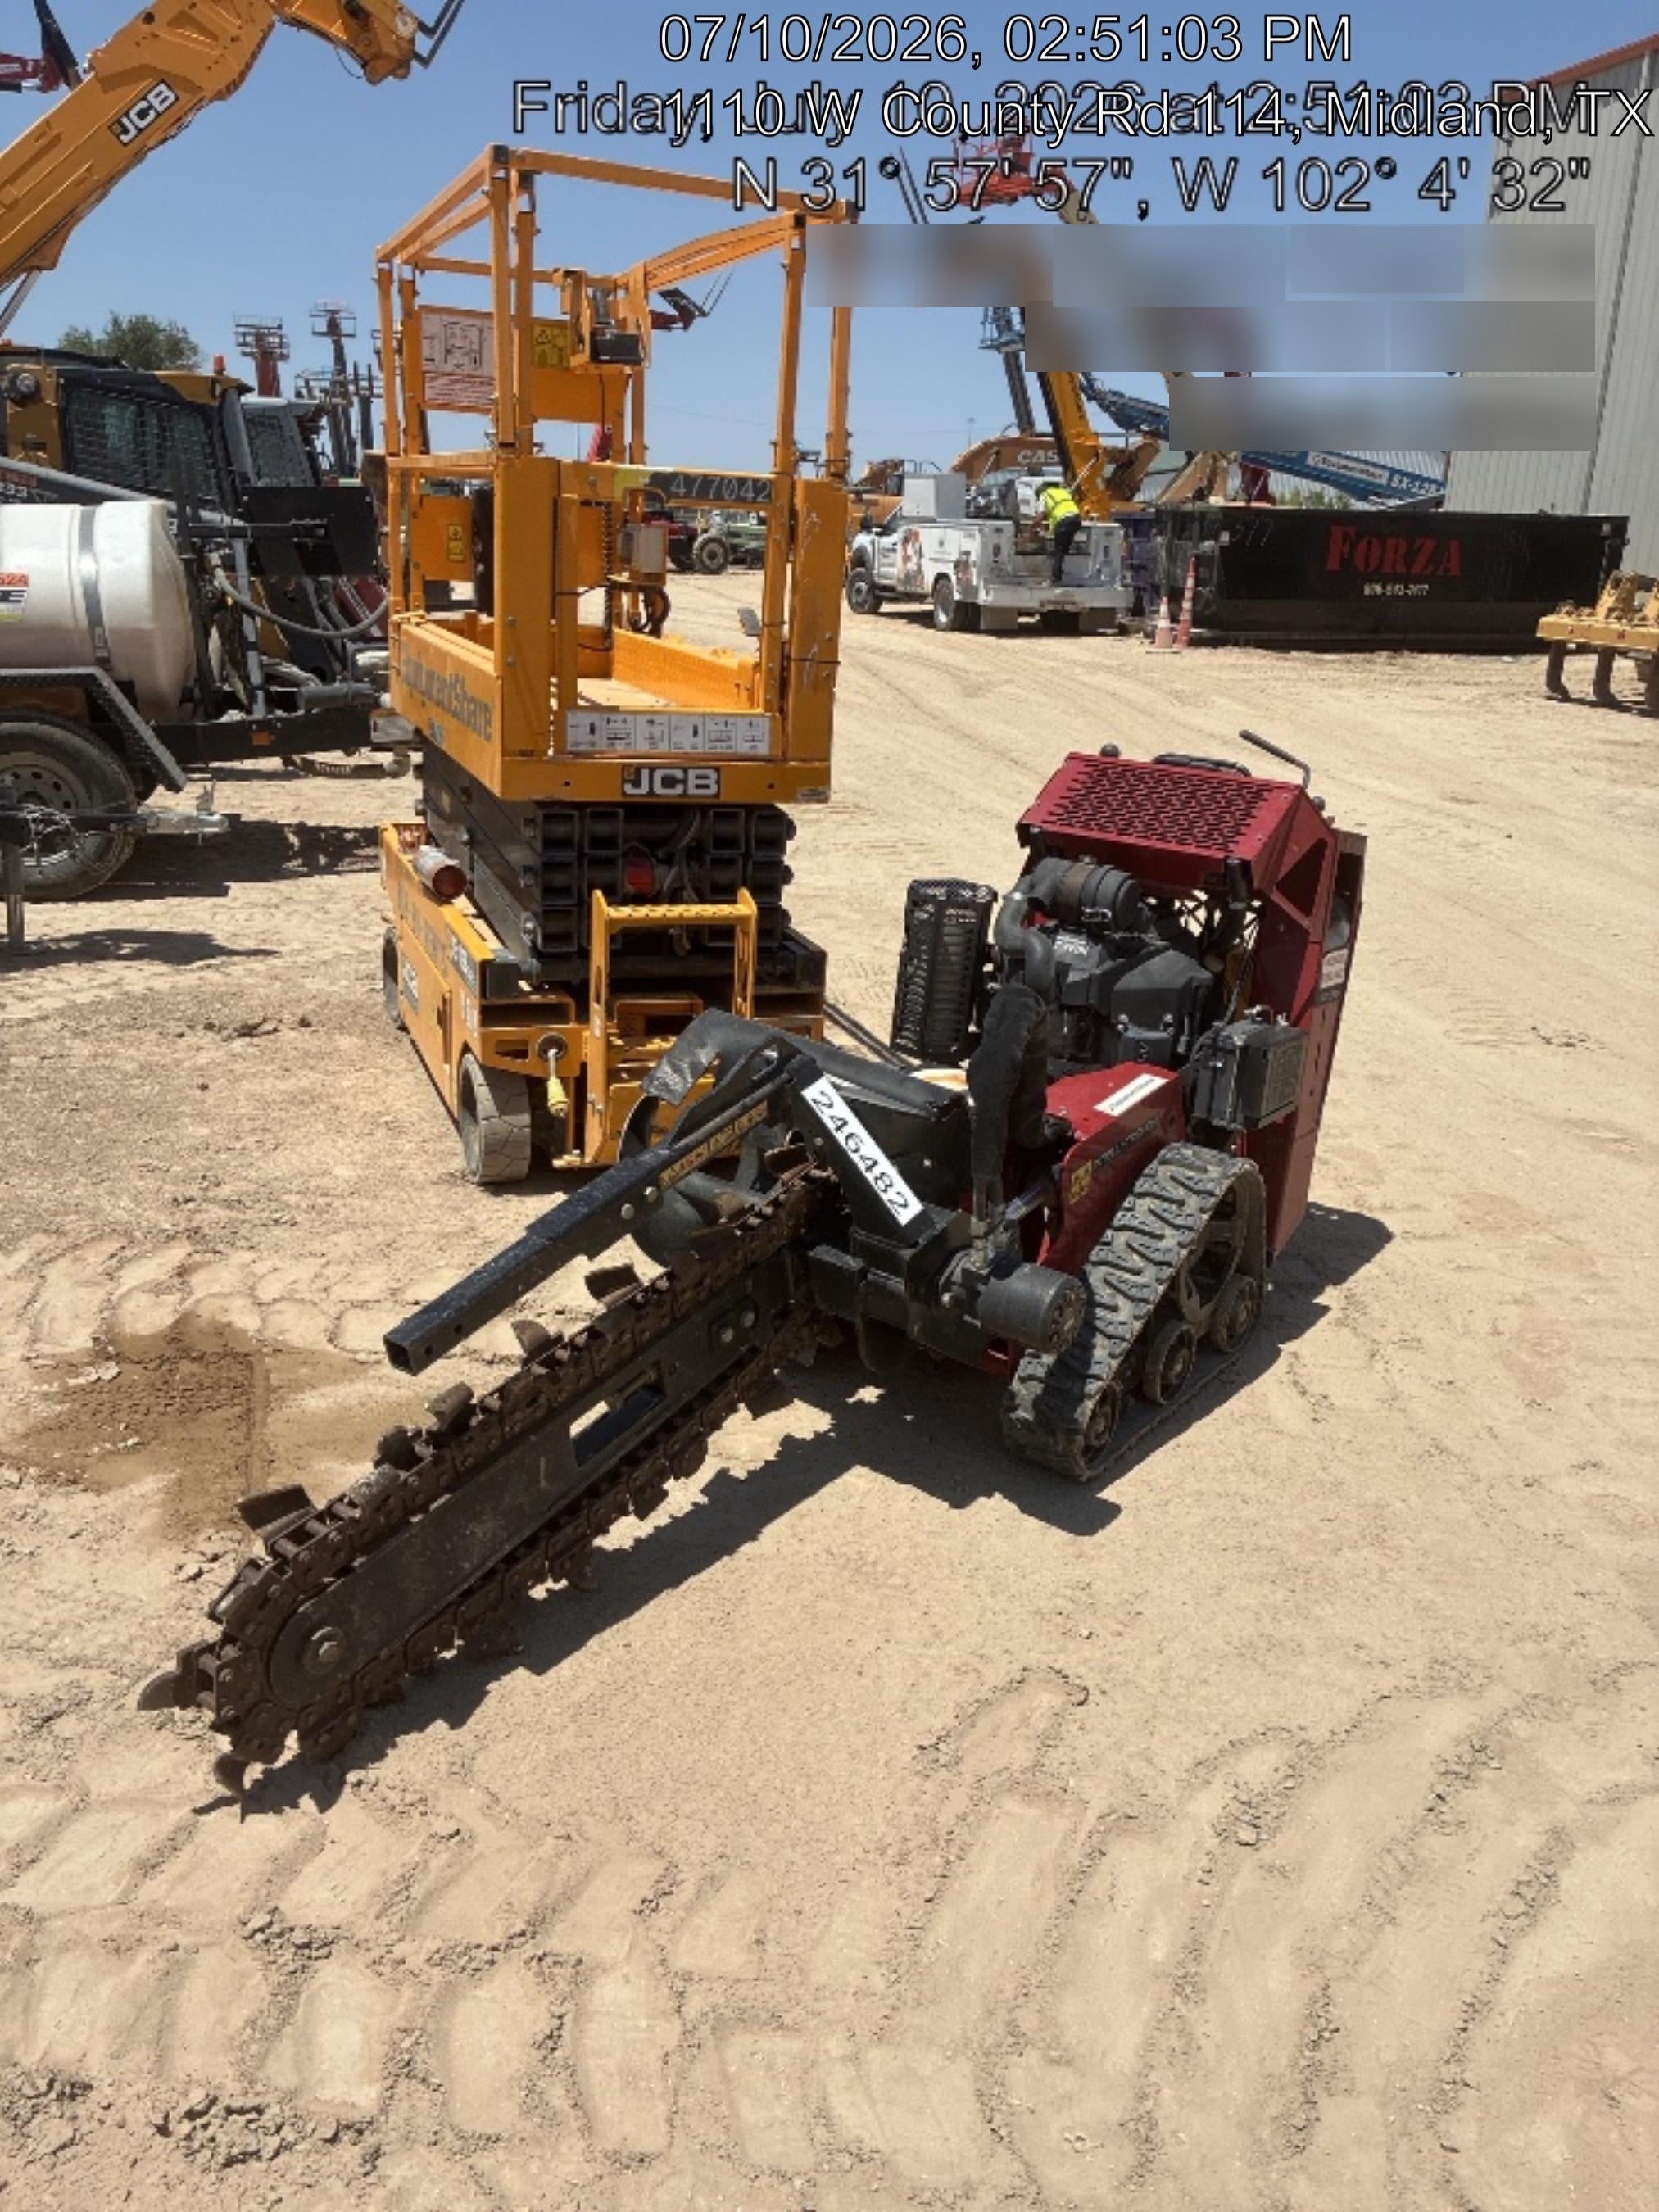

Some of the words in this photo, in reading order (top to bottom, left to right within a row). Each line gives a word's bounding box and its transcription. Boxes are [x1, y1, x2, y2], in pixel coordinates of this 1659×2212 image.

[119, 82, 177, 145] JCB
[1017, 449, 1059, 465] CAS
[623, 767, 719, 796] JCB
[810, 1090, 910, 1215] 246482
